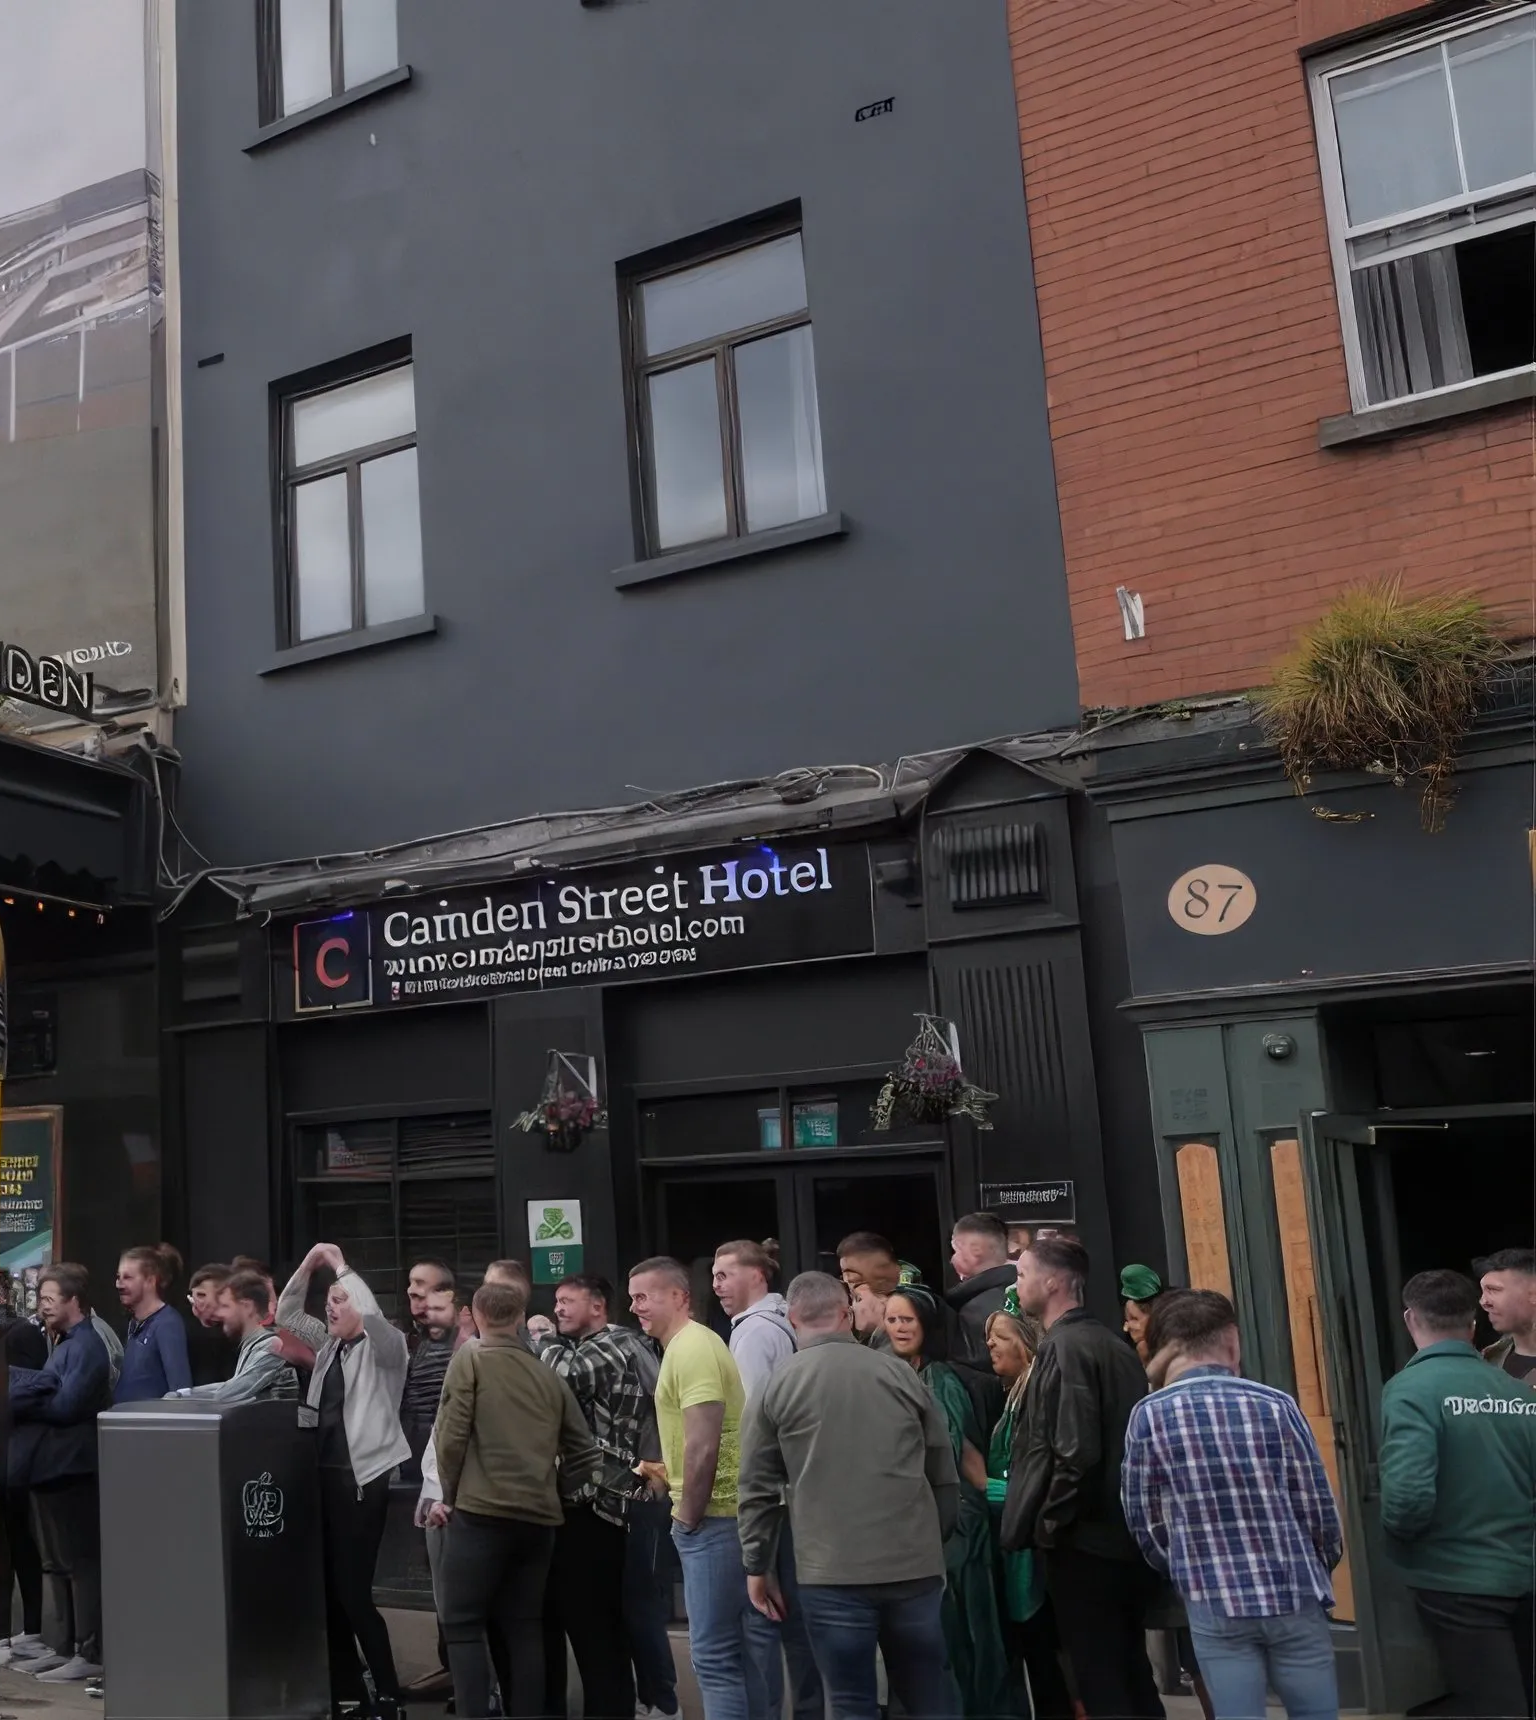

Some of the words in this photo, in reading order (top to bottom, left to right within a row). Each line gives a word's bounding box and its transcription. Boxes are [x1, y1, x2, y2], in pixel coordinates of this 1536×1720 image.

[383, 895, 546, 947] Camden
[558, 869, 689, 926] Street
[698, 847, 833, 906] Hotel
[1183, 878, 1243, 923] 87
[316, 937, 350, 989] C
